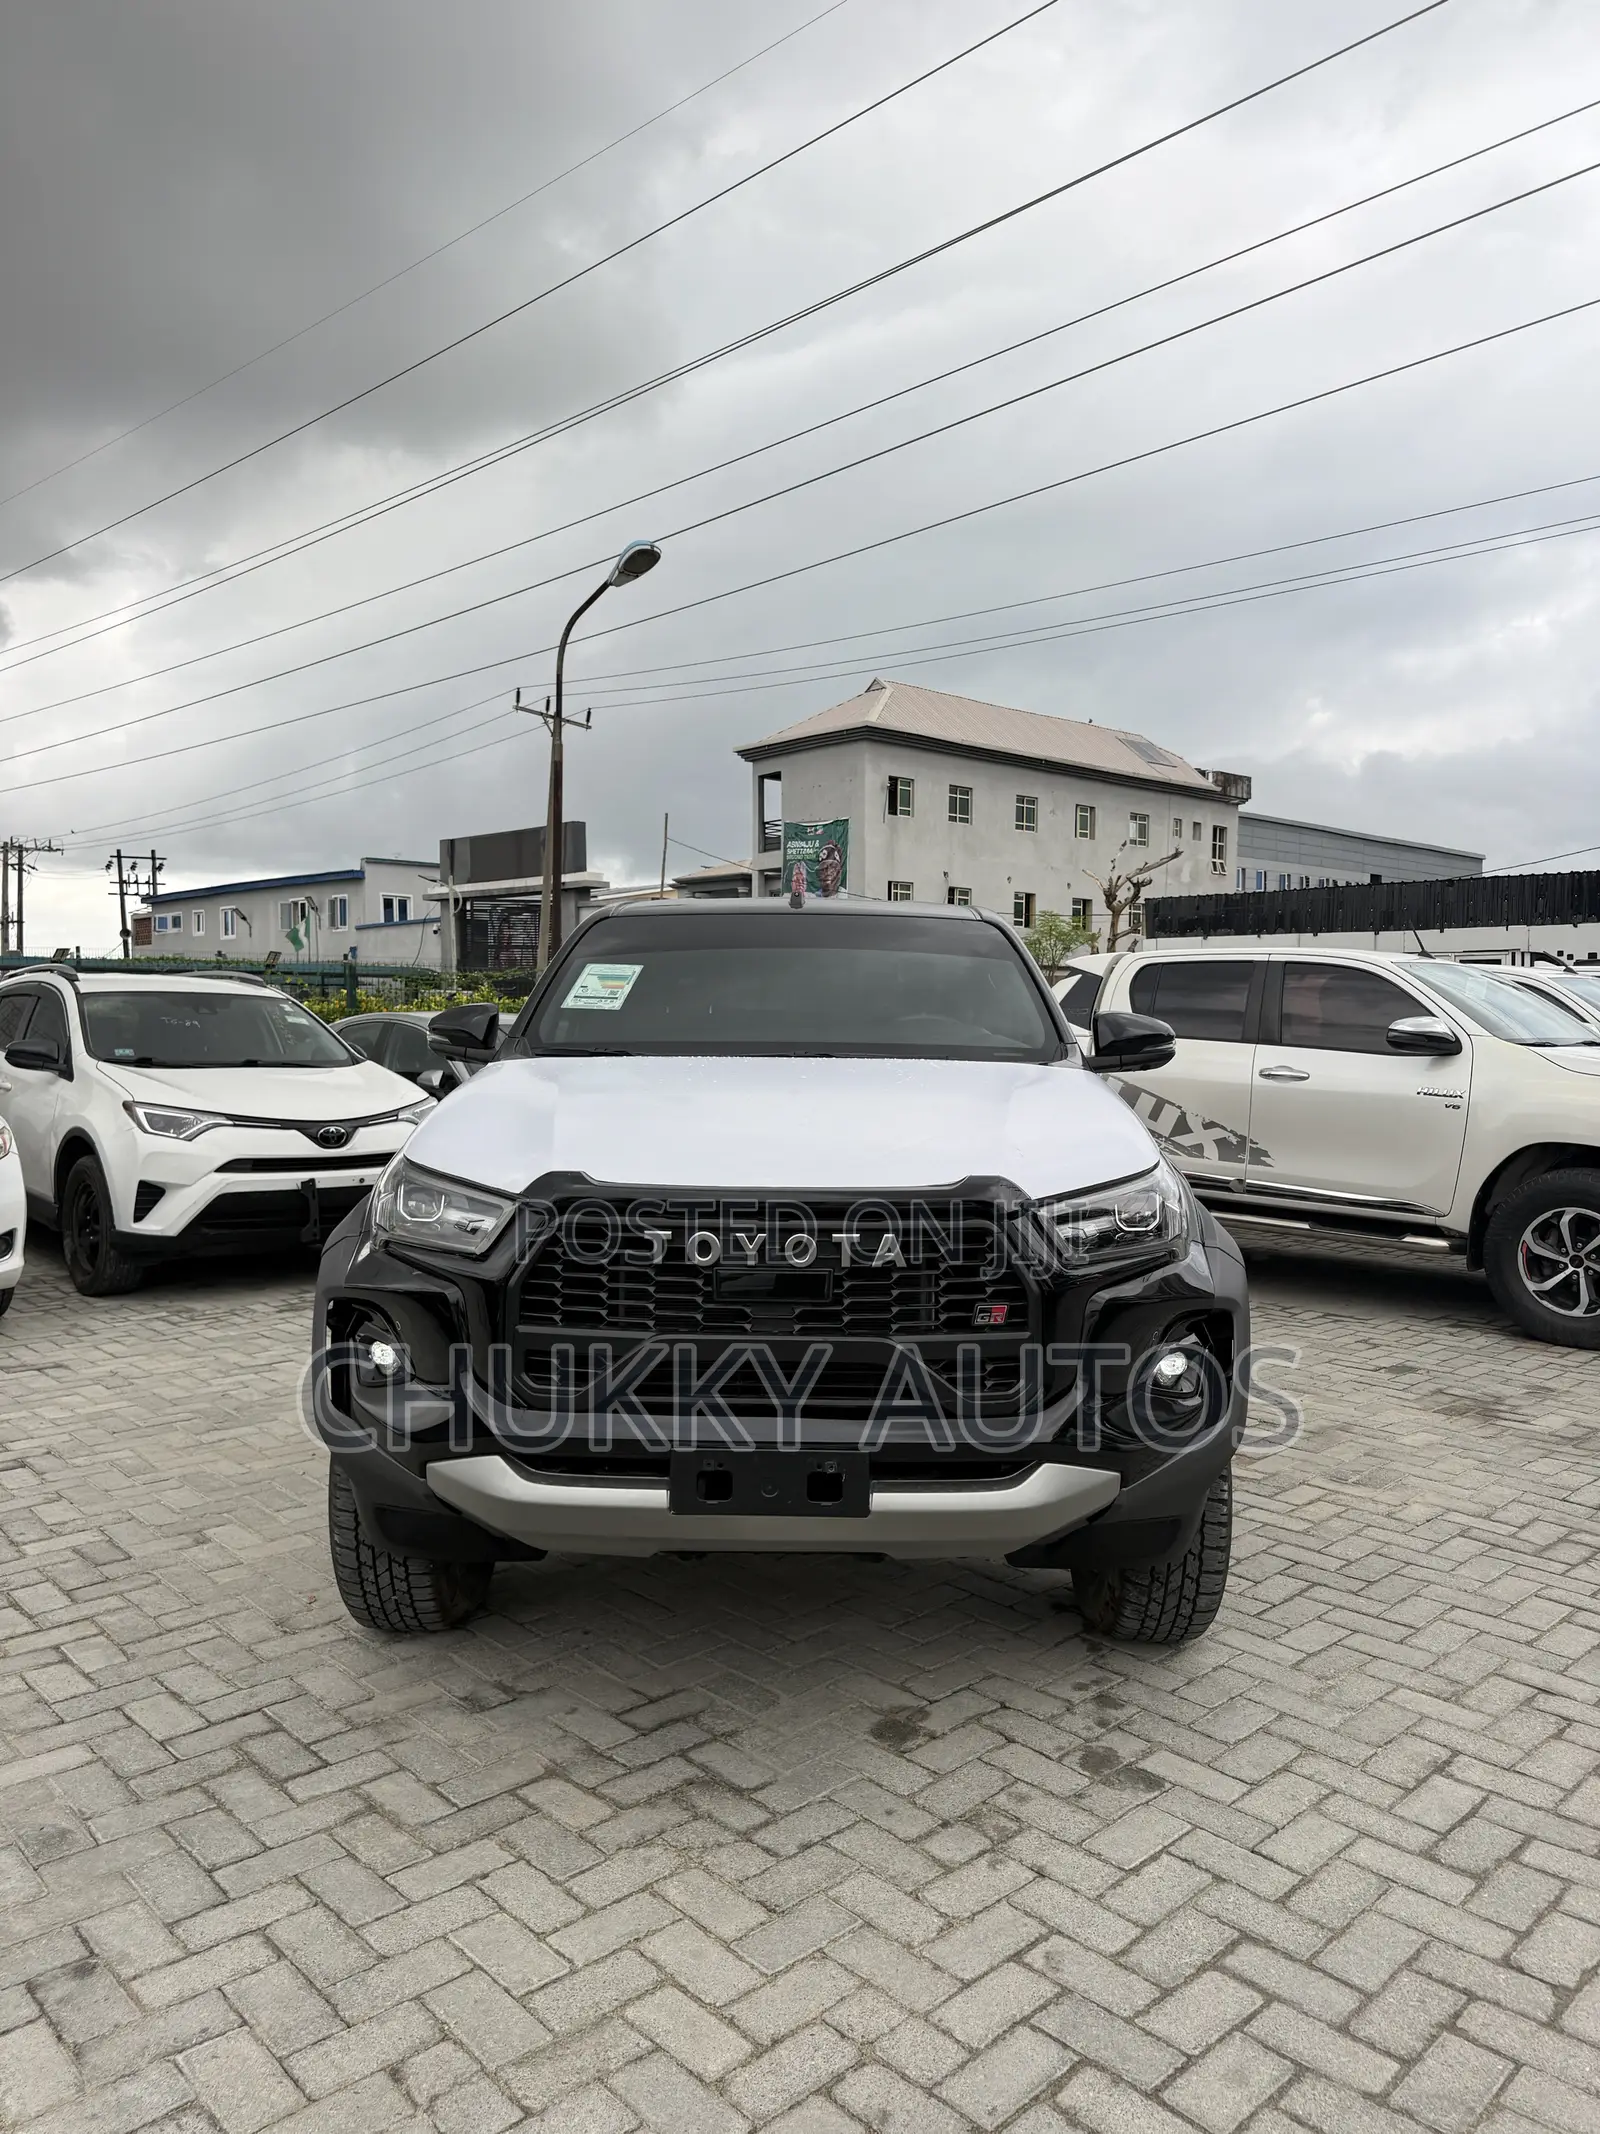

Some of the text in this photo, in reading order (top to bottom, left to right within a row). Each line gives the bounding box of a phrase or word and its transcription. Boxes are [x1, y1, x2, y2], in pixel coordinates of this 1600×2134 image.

[1416, 1086, 1466, 1099] HILUX
[1444, 1102, 1462, 1110] V6
[644, 1230, 907, 1268] TOYOTA
[976, 1311, 1004, 1323] GR
